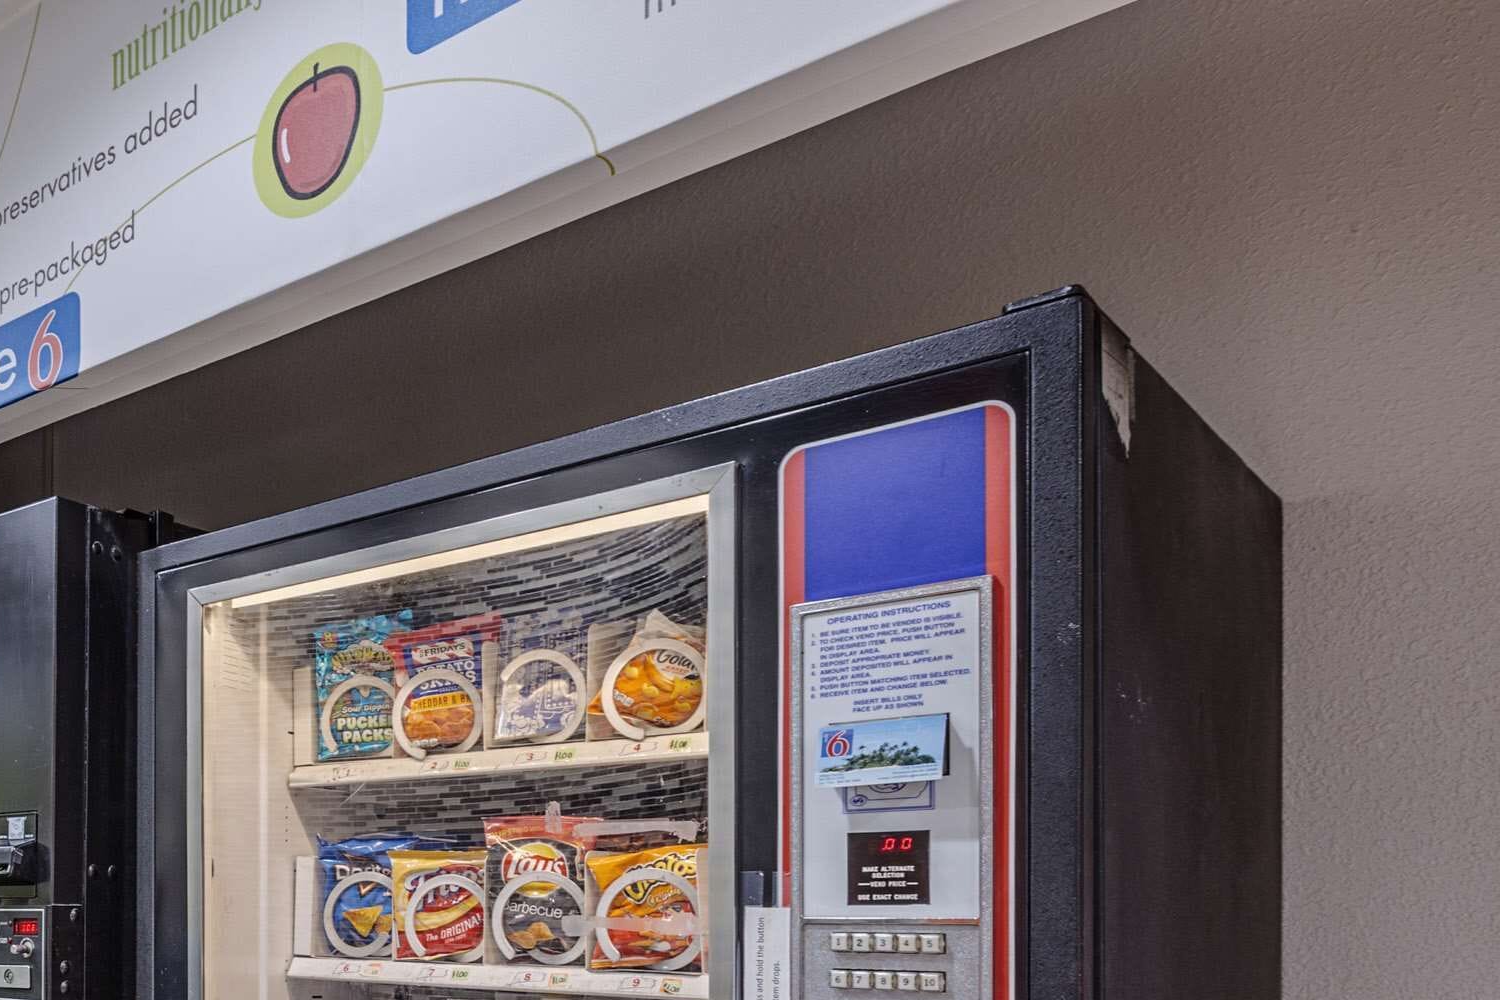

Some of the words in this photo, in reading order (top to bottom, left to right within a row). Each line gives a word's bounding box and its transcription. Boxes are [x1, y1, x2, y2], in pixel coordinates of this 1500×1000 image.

[112, 0, 262, 91] nutritiona
[124, 83, 199, 156] added
[0, 210, 137, 316] pre-packaged
[27, 308, 63, 391] 6
[827, 611, 879, 625] OPERATING
[881, 601, 951, 617] INSTRUCTIONS
[343, 730, 393, 743] PACKS
[826, 730, 850, 757] 6
[334, 864, 391, 880] Dorito
[756, 917, 765, 944] button
[756, 946, 764, 958] the
[756, 959, 764, 977] hold
[772, 960, 780, 986] drops.
[633, 979, 640, 987] 9
[924, 978, 935, 987] 10
